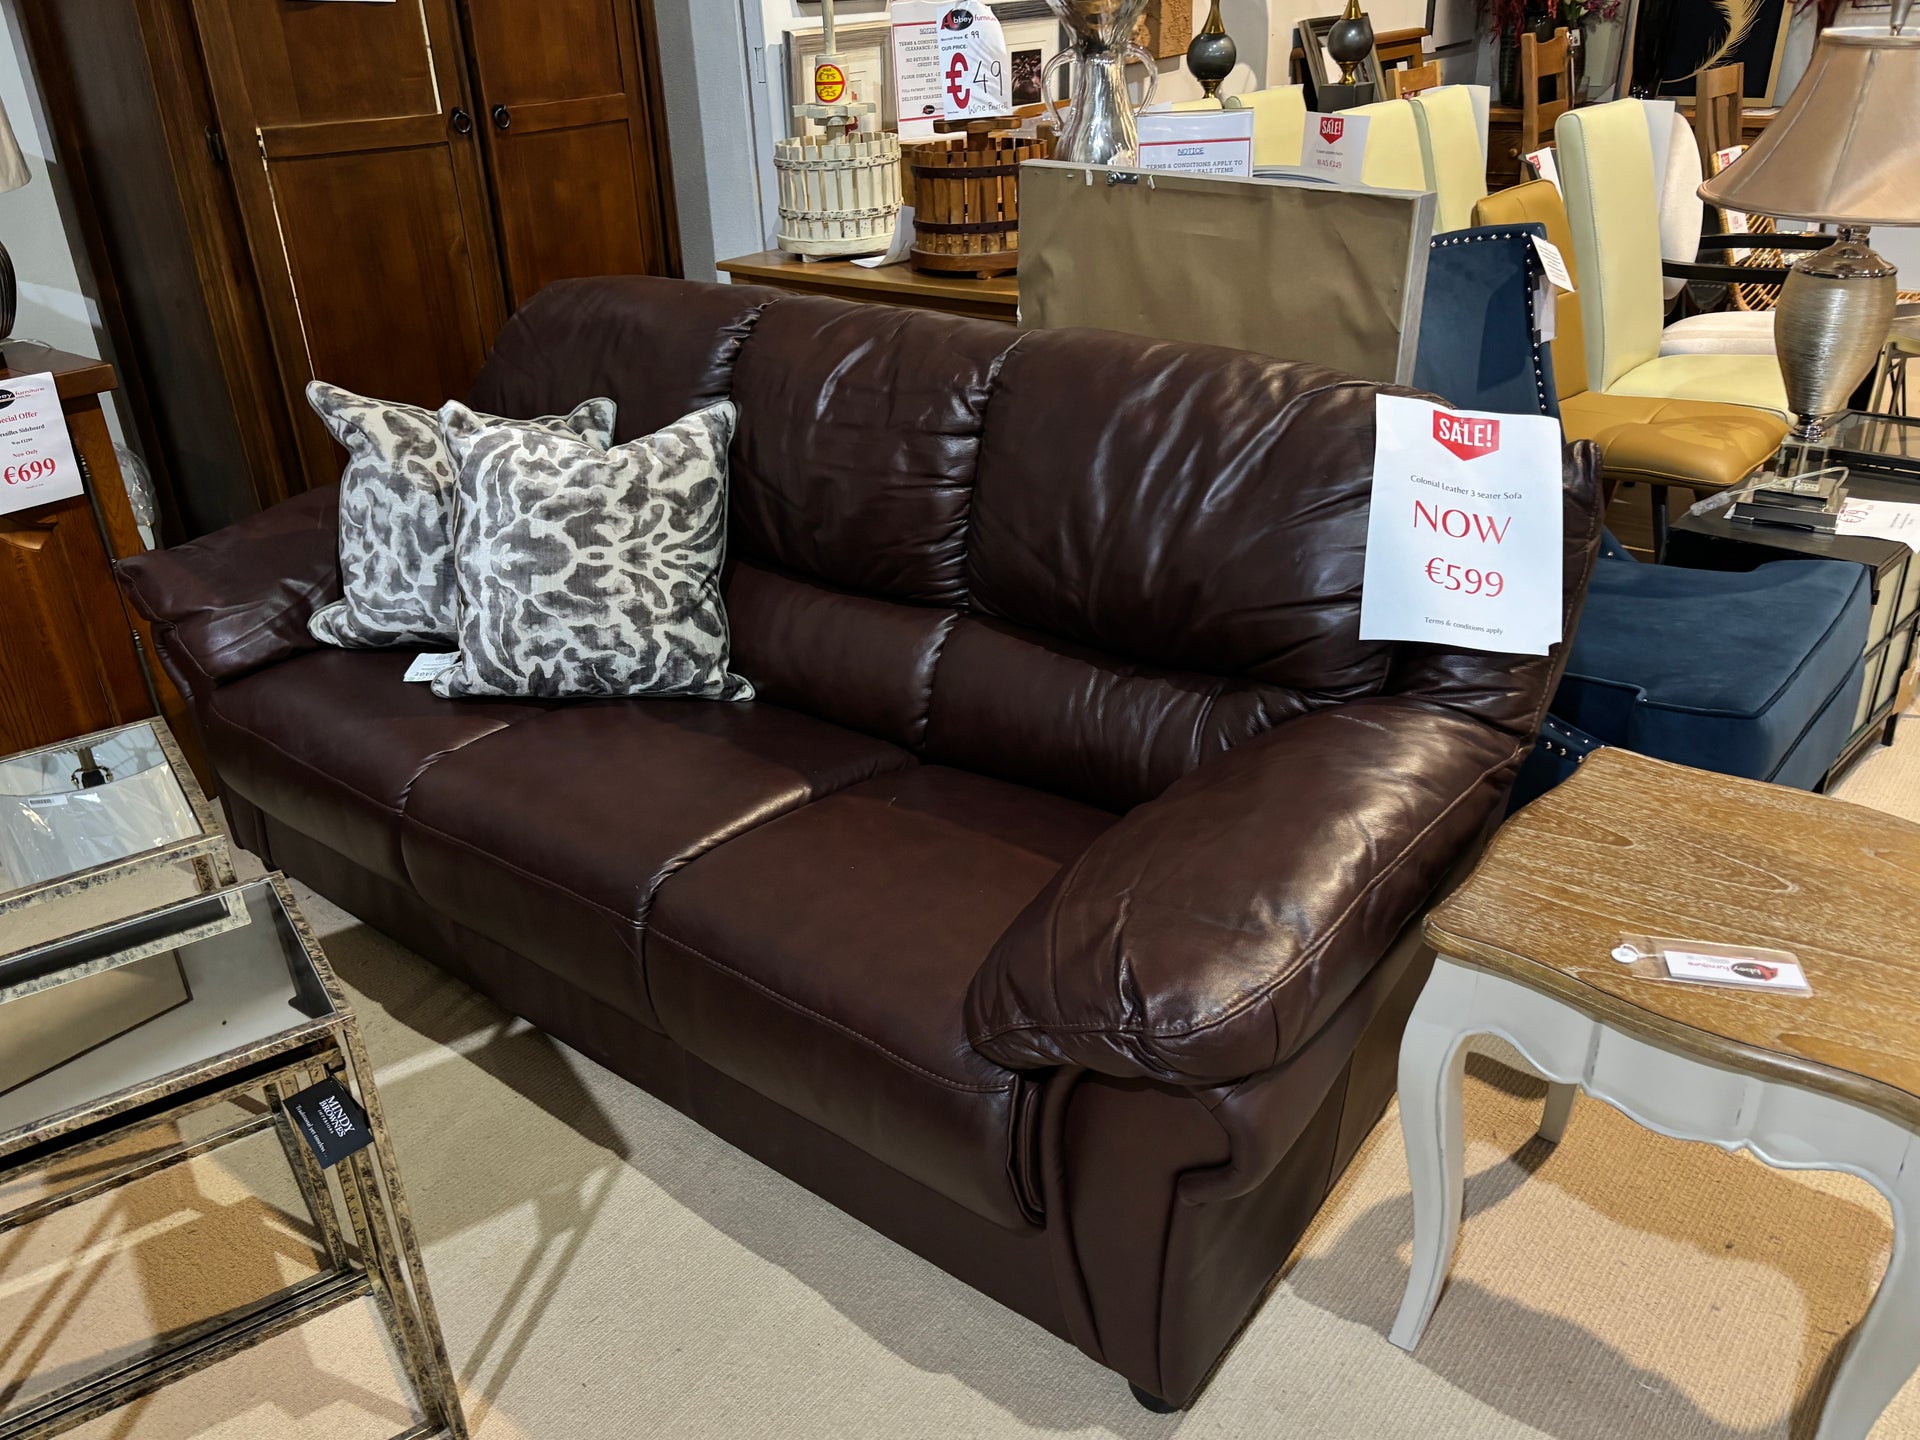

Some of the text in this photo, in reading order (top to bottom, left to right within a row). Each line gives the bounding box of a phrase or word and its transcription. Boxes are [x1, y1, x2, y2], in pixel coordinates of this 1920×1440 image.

[1173, 161, 1211, 169] CONDITIONS
[1177, 147, 1205, 156] NOTICE
[18, 411, 38, 420] Offer
[1439, 418, 1493, 448] SALE!
[4, 457, 56, 485] €699
[1410, 474, 1522, 500] Colonial Leather 3 seater Sofa
[1413, 499, 1512, 545] NOW
[1425, 557, 1504, 598] €599
[1424, 616, 1444, 626] Terms
[1453, 621, 1485, 632] conditions
[1485, 627, 1503, 635] apply
[295, 1104, 314, 1128] Traditional
[308, 1127, 317, 1135] yet
[317, 1109, 335, 1134] INTERIORS
[319, 1100, 346, 1138] BROWNES
[325, 1095, 356, 1133] MINDY
